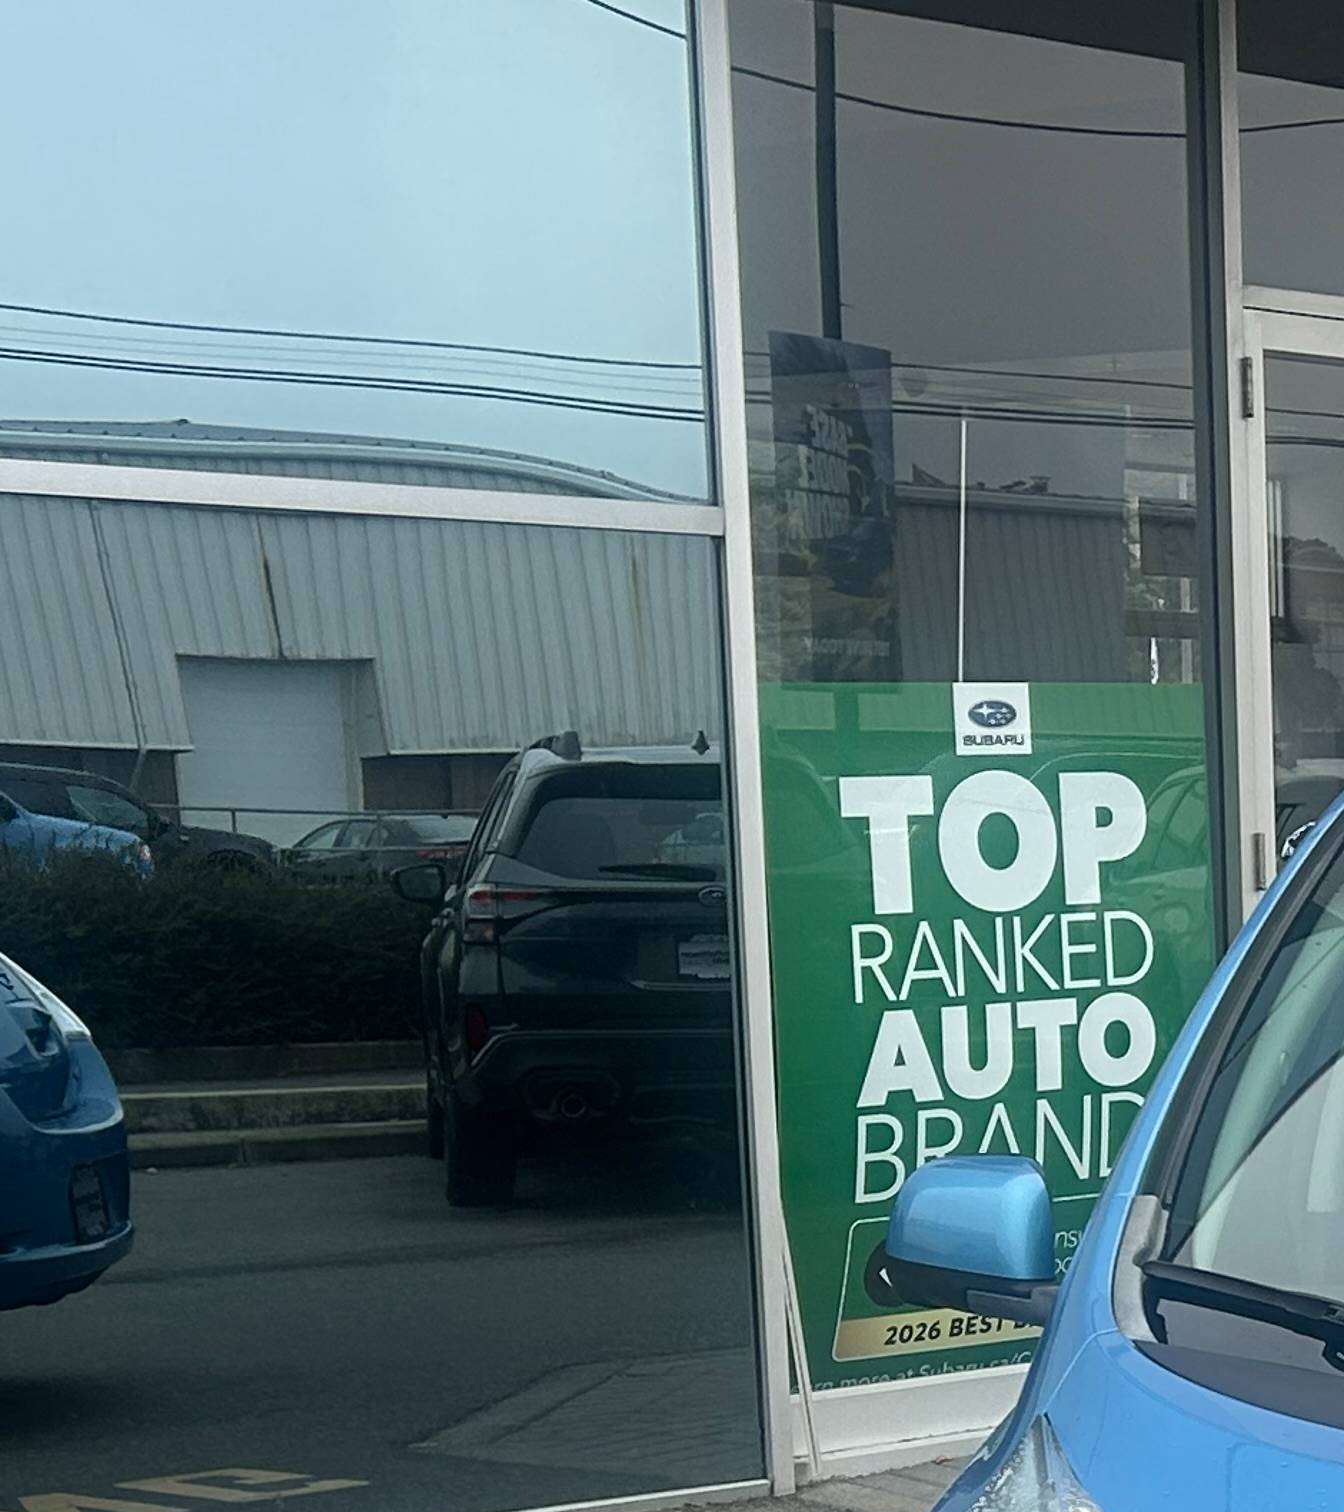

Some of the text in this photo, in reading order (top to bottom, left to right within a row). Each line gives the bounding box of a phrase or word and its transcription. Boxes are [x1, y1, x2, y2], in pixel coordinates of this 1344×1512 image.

[962, 734, 1025, 746] SUBARU
[839, 770, 1147, 914] TOP
[850, 910, 1154, 1003] RANKED
[856, 992, 1156, 1108] AUTO
[884, 1315, 1003, 1346] 2026 BEST
